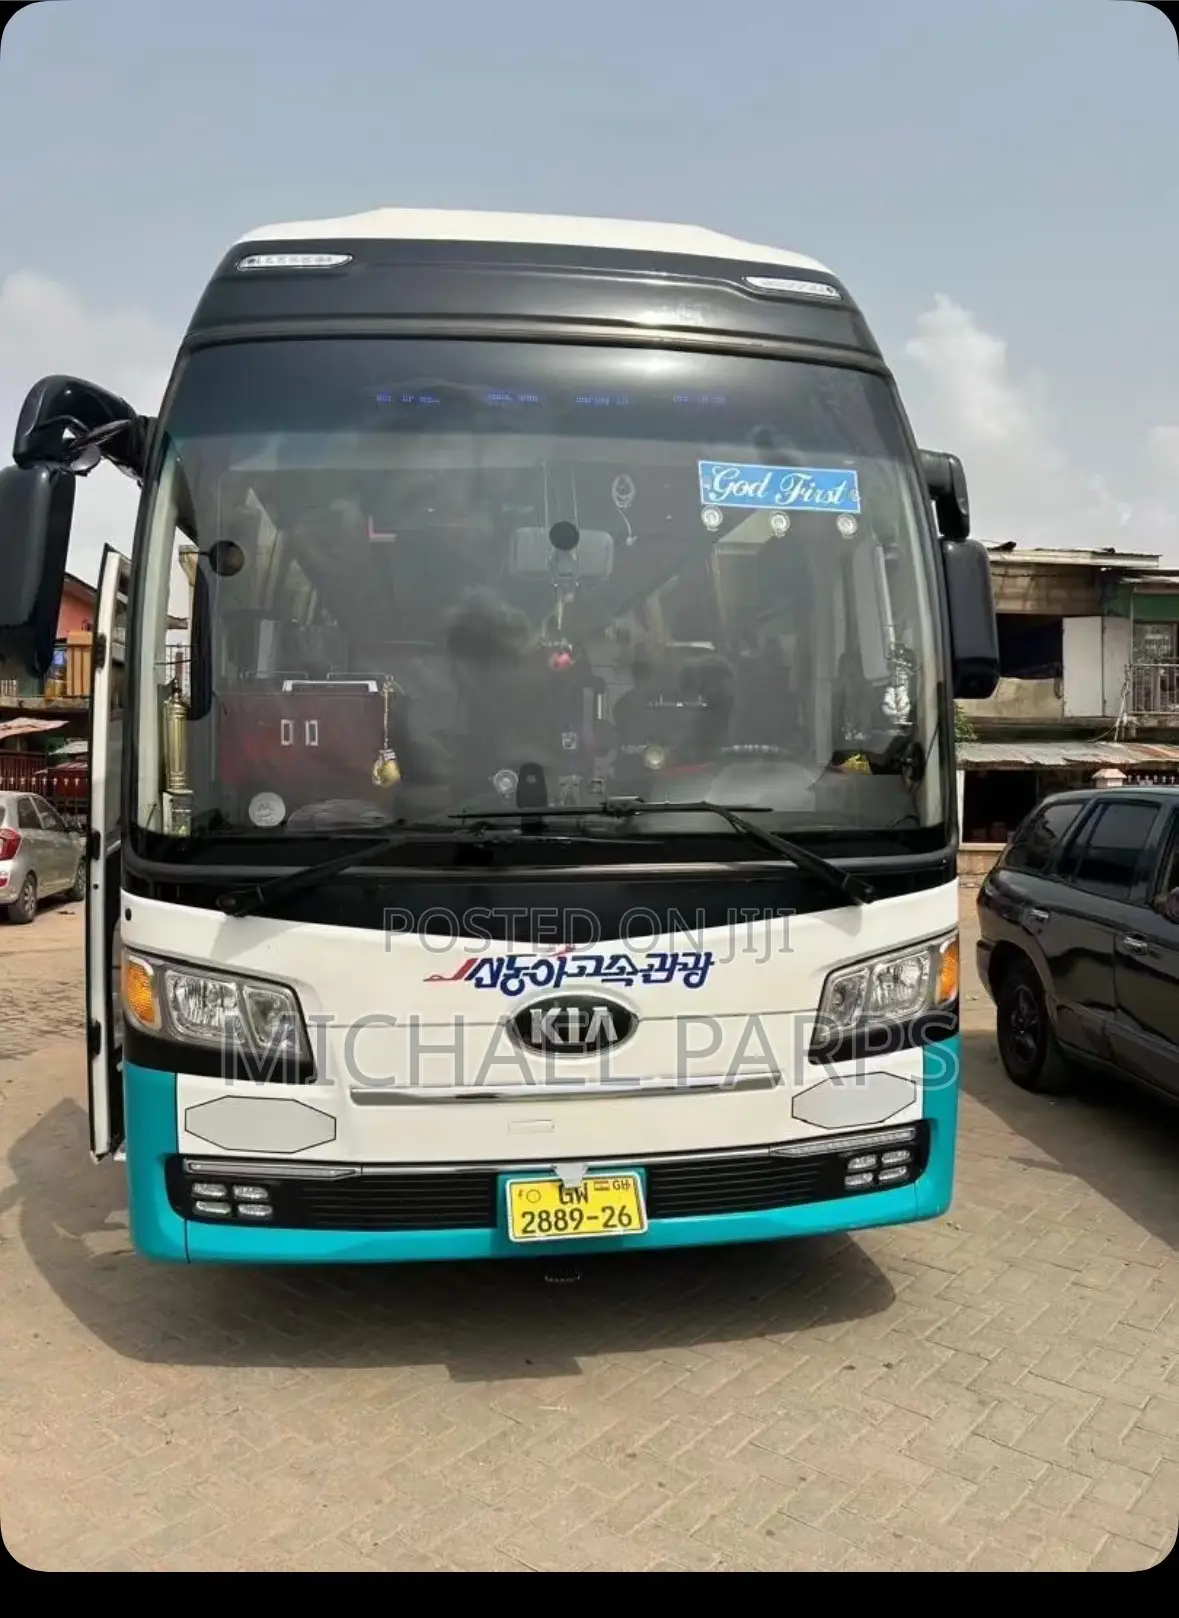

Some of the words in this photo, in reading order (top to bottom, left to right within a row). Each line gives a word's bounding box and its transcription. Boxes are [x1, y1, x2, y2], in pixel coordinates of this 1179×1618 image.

[709, 466, 773, 500] God
[775, 473, 847, 504] First
[530, 1007, 618, 1045] KIA
[520, 1205, 633, 1235] 2889-26
